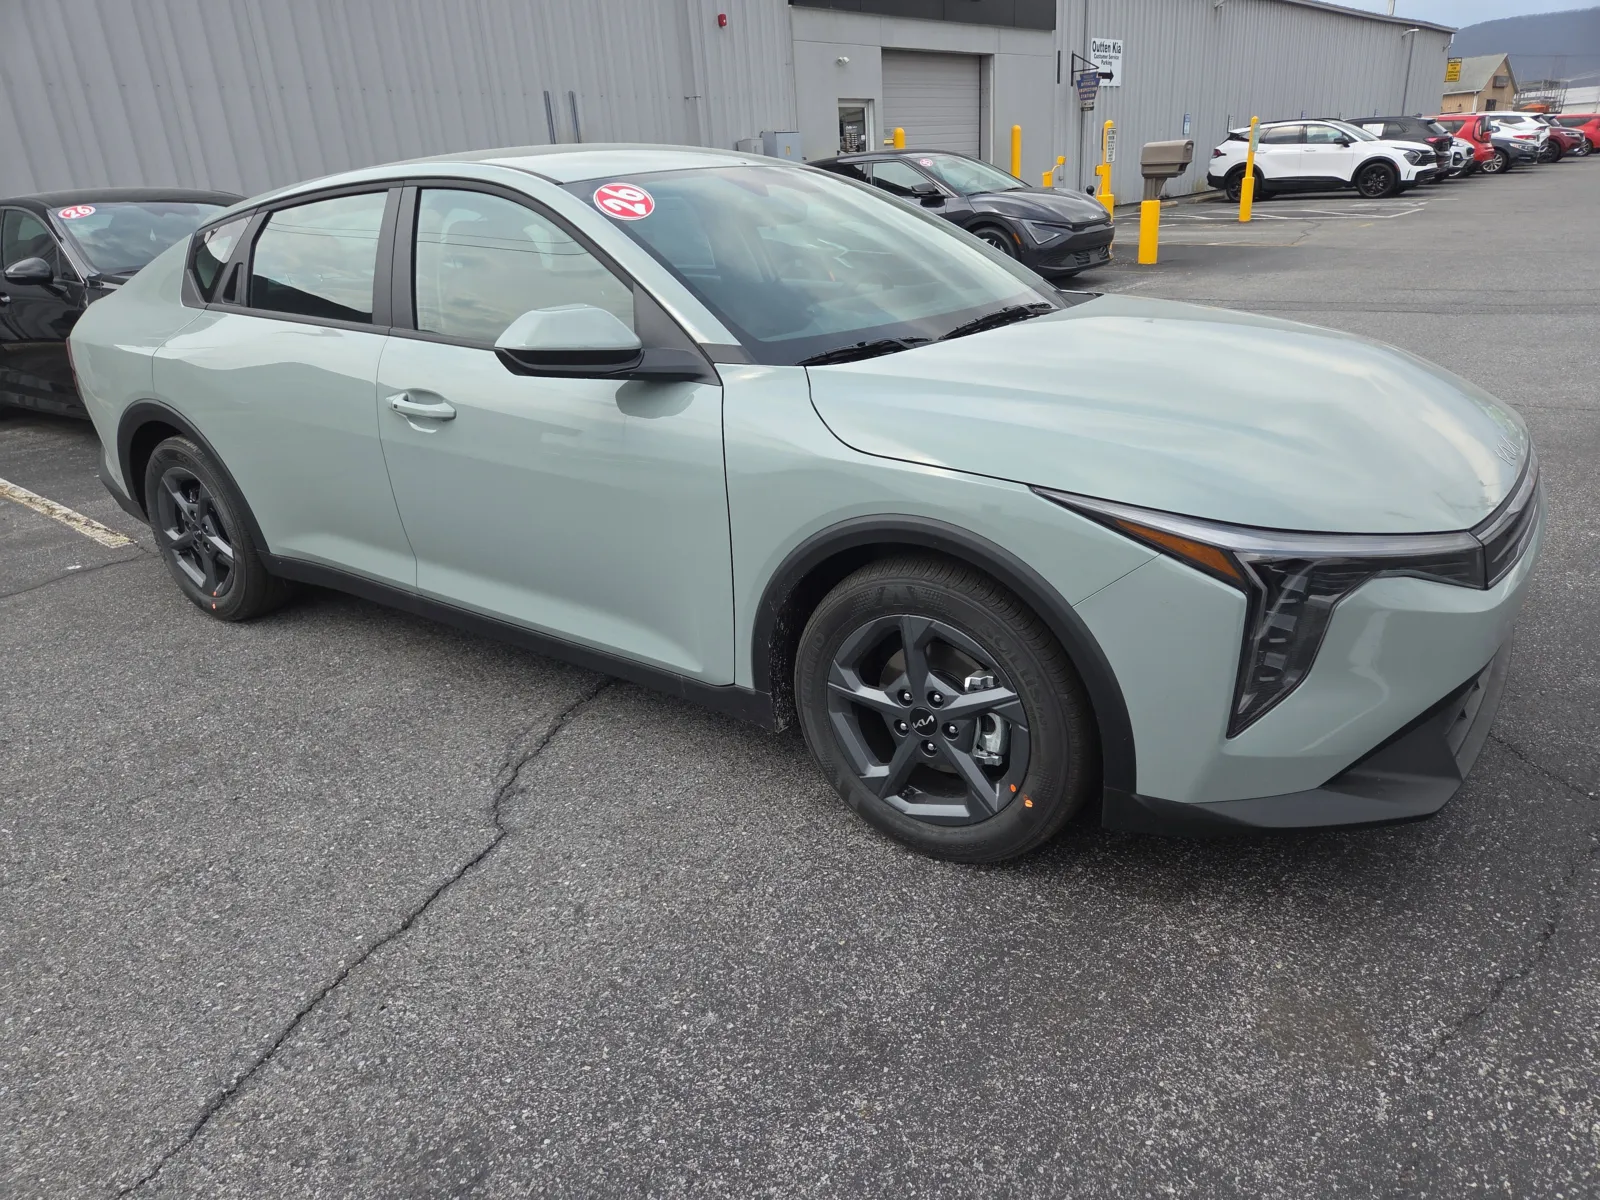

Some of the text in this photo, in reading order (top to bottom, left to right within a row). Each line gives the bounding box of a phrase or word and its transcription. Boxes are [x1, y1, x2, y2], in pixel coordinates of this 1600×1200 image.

[1092, 40, 1122, 54] Outten Kia
[601, 188, 647, 215] 26
[64, 205, 92, 218] 26
